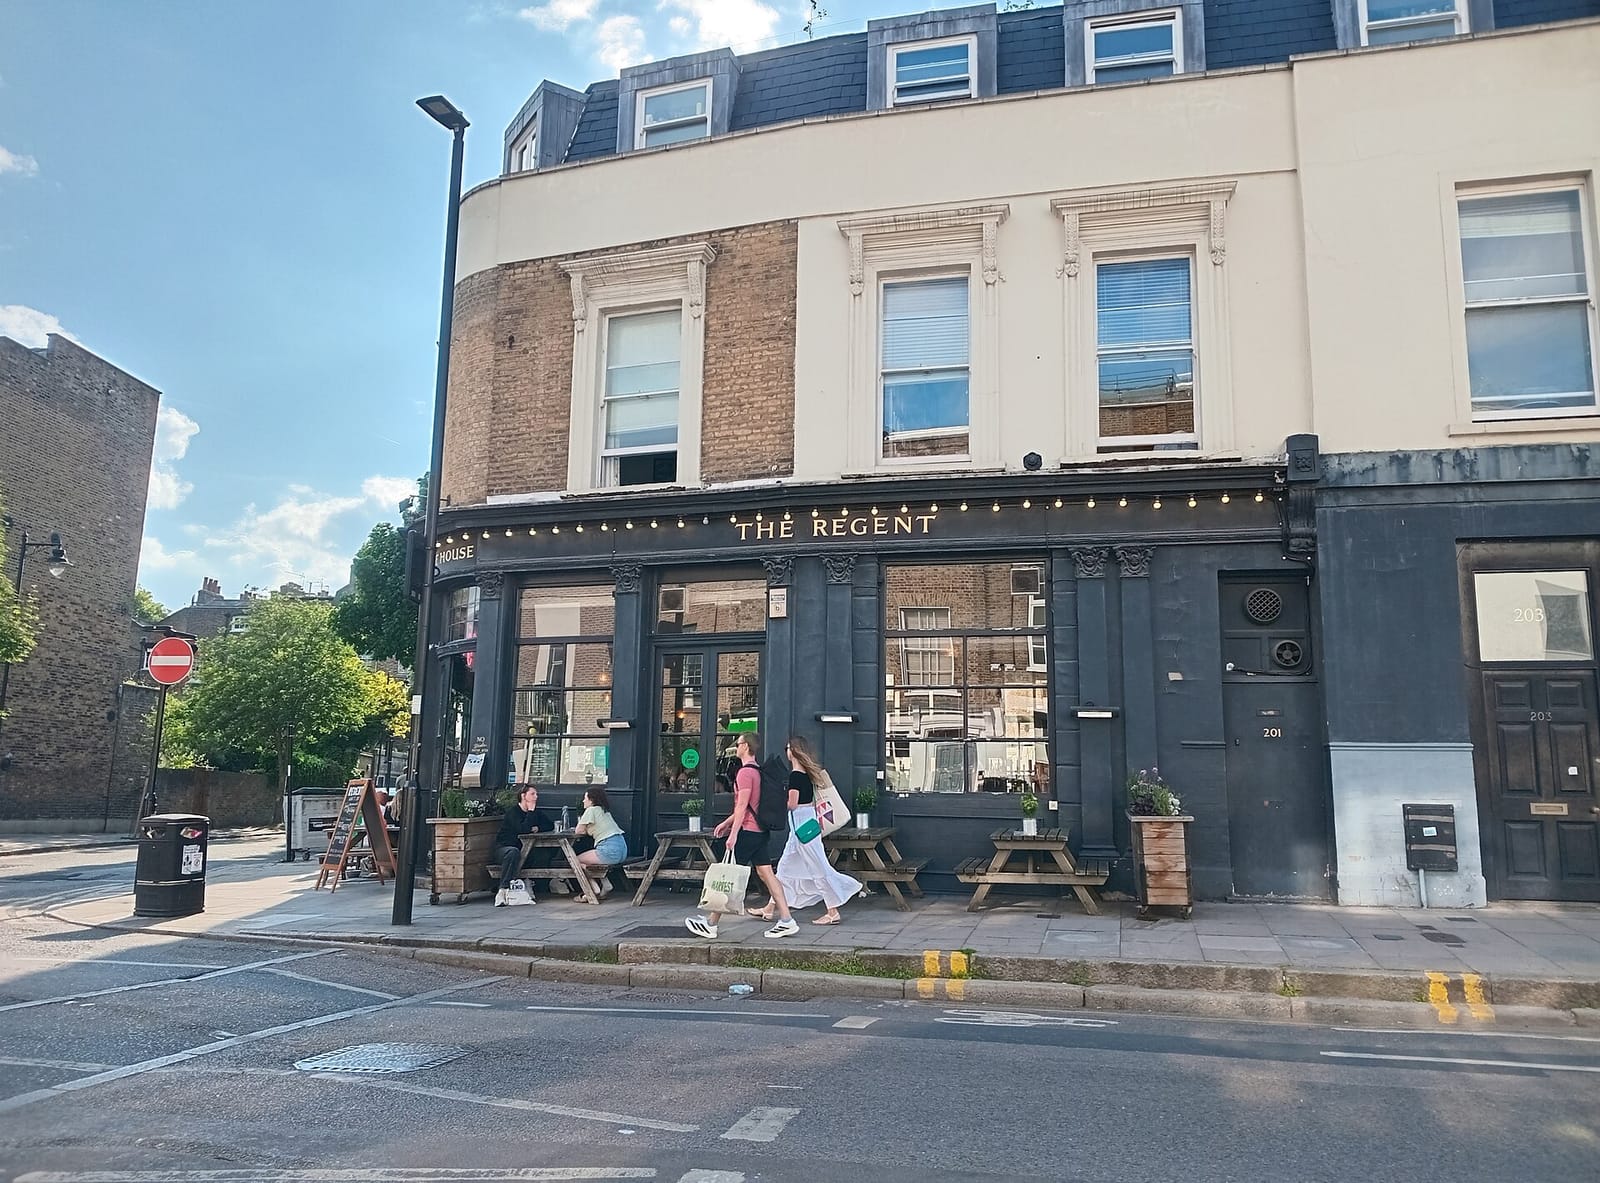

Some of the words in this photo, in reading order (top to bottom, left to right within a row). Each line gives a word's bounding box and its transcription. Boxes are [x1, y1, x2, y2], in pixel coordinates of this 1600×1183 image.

[735, 519, 795, 541] THE
[812, 514, 937, 537] REGENT
[439, 545, 475, 564] HOUSE
[1513, 608, 1544, 622] 203
[1530, 711, 1552, 721] 203
[1263, 728, 1281, 738] 201
[711, 880, 735, 893] HARVEST
